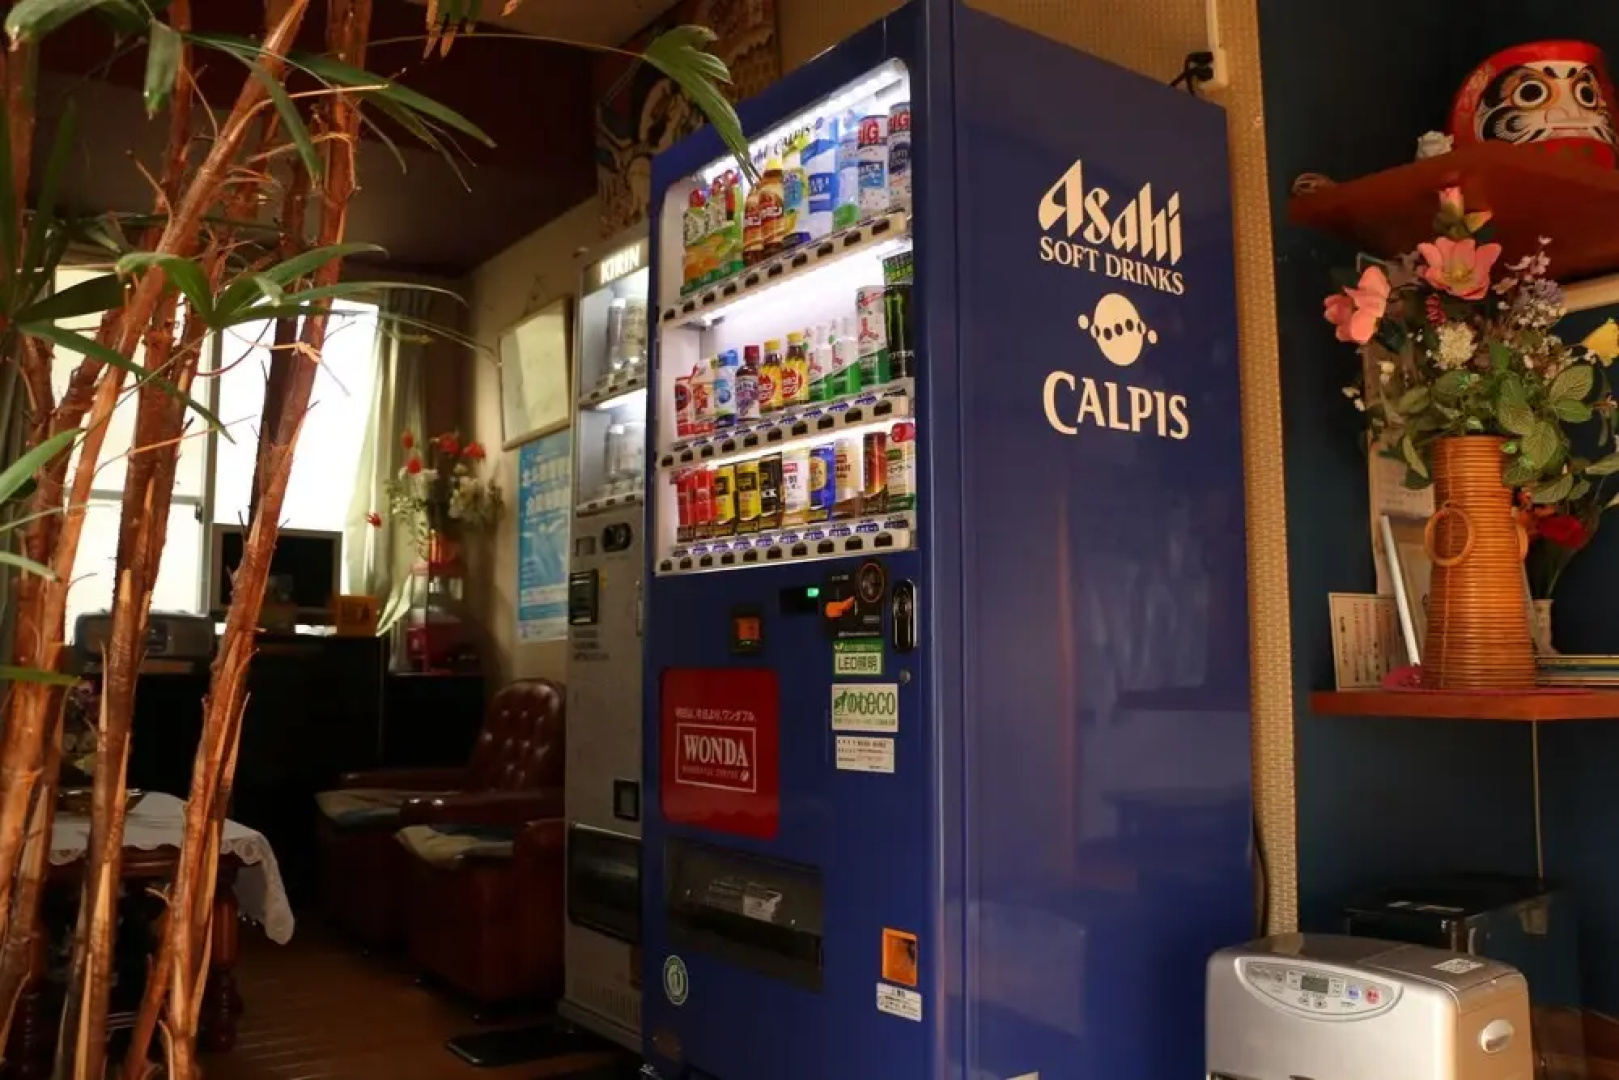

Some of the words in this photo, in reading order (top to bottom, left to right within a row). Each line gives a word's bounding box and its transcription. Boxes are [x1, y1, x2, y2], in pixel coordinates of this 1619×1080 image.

[1038, 159, 1183, 266] Asahi
[600, 245, 641, 285] KIRIN
[1039, 236, 1100, 273] SOFT
[1105, 252, 1185, 296] DRINKS
[1043, 370, 1190, 440] CALPIS
[683, 734, 749, 767] WONDA
